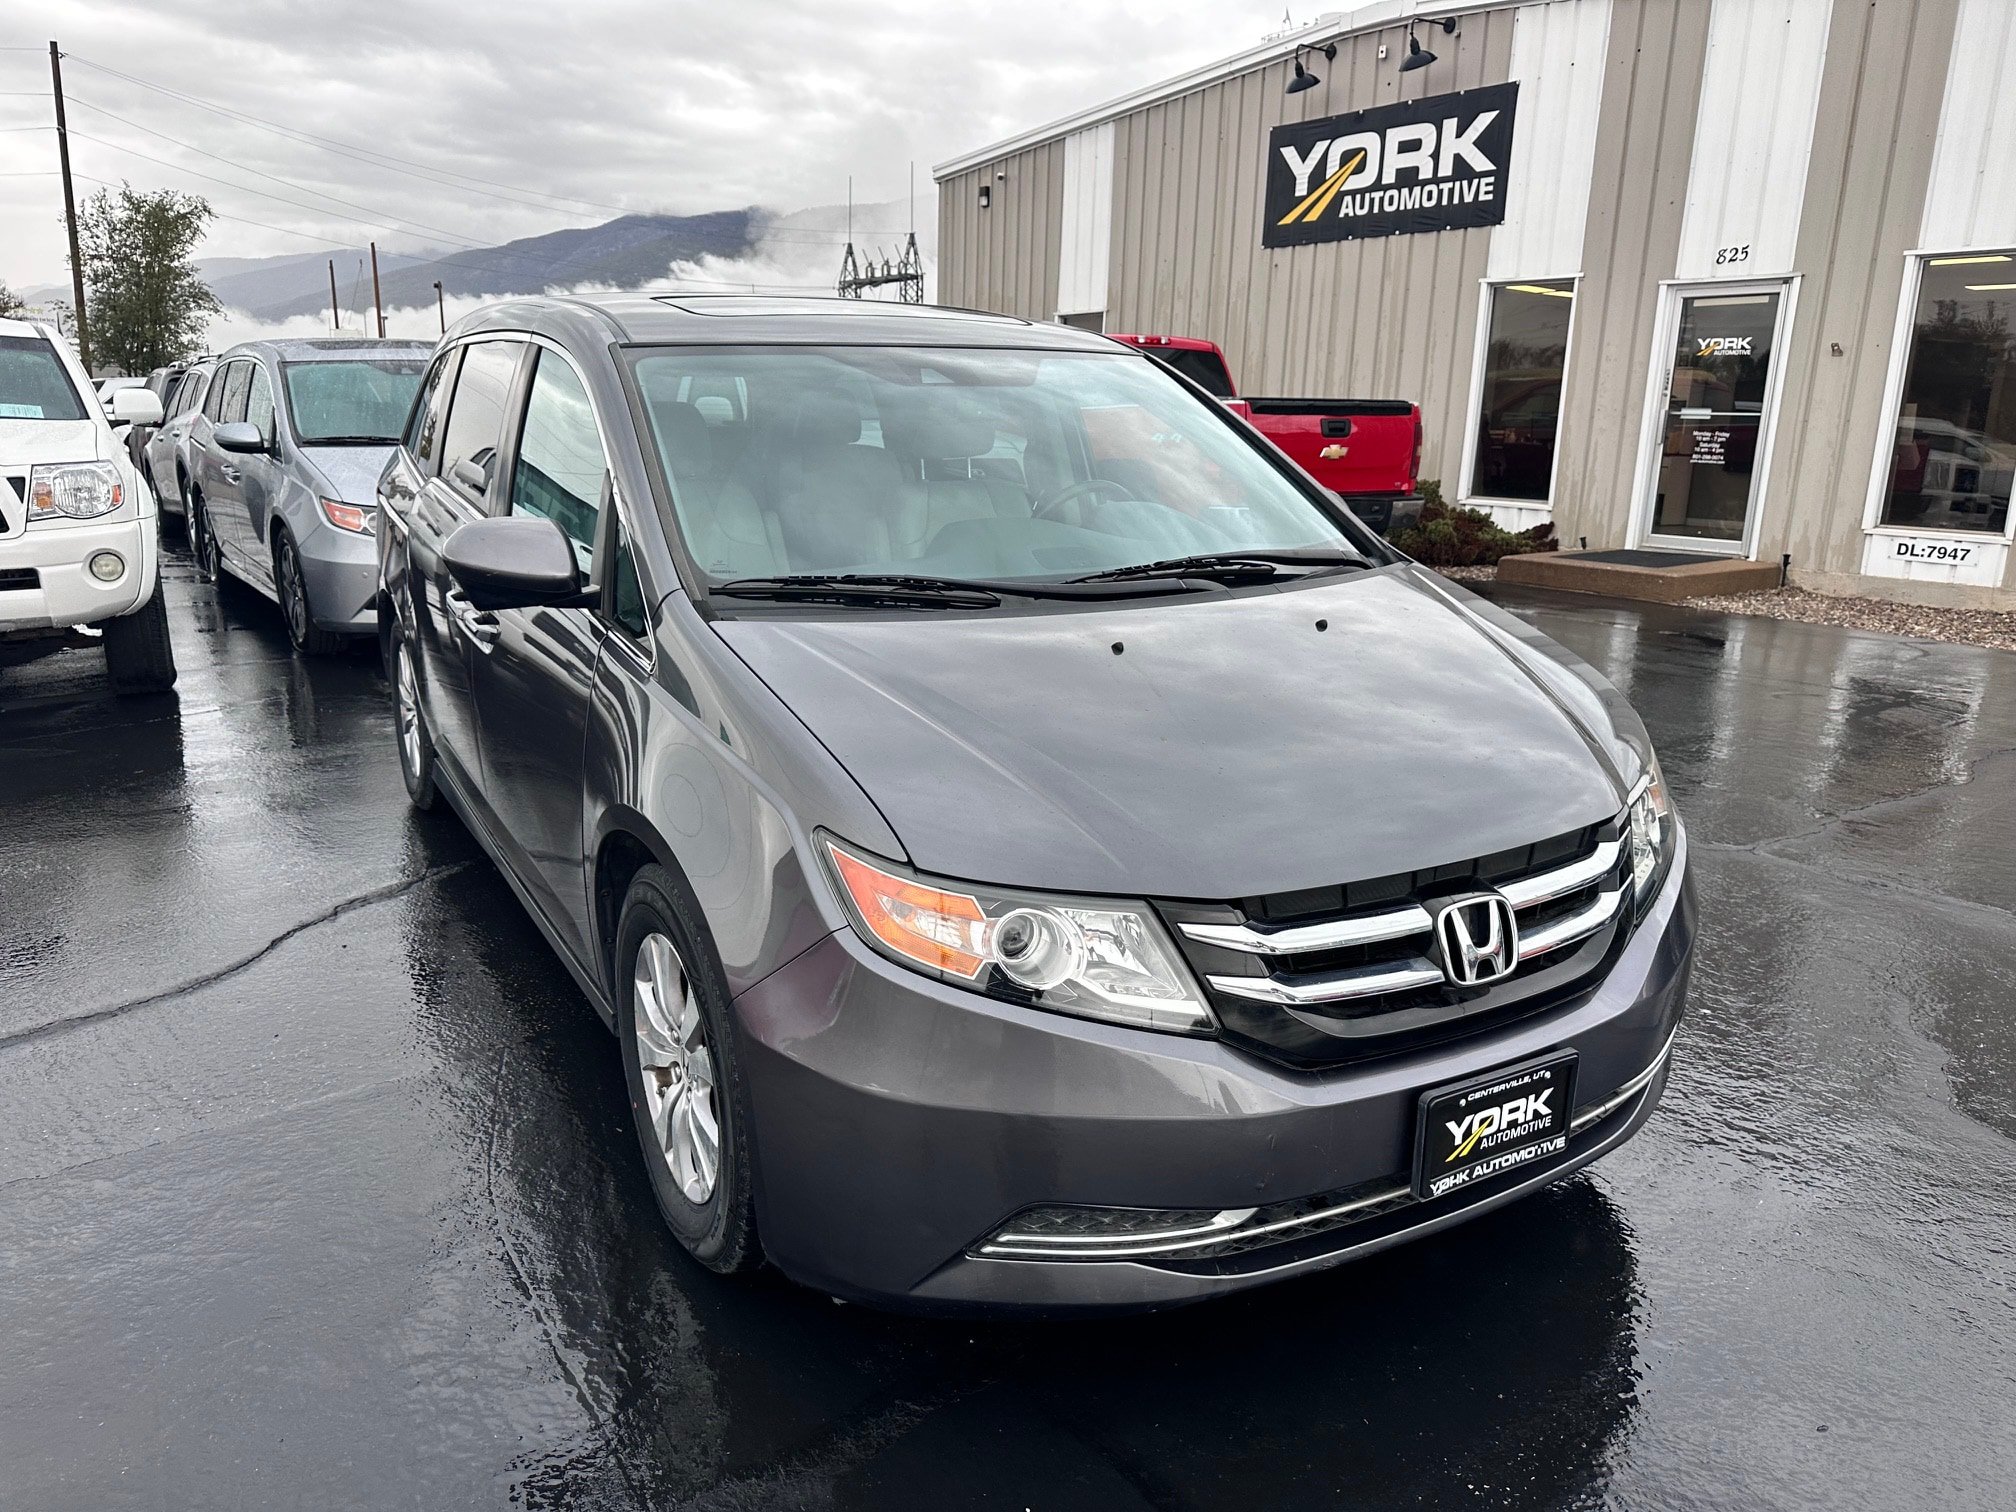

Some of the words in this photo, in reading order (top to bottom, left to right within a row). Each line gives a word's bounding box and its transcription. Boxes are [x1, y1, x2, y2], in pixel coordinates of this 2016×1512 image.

[1279, 109, 1500, 197] YORK
[1338, 176, 1495, 218] AUTOMOTIVE
[1716, 244, 1750, 265] 825
[1697, 336, 1753, 350] YORK
[1896, 542, 1971, 562] DL:7947
[1467, 1075, 1532, 1101] CENTERVILLE,
[1532, 1070, 1546, 1080] UT
[1445, 1087, 1554, 1146] YORK
[1480, 1115, 1552, 1150] AUTOMOTIVE
[1472, 1136, 1566, 1179] AUTOMOTIVE
